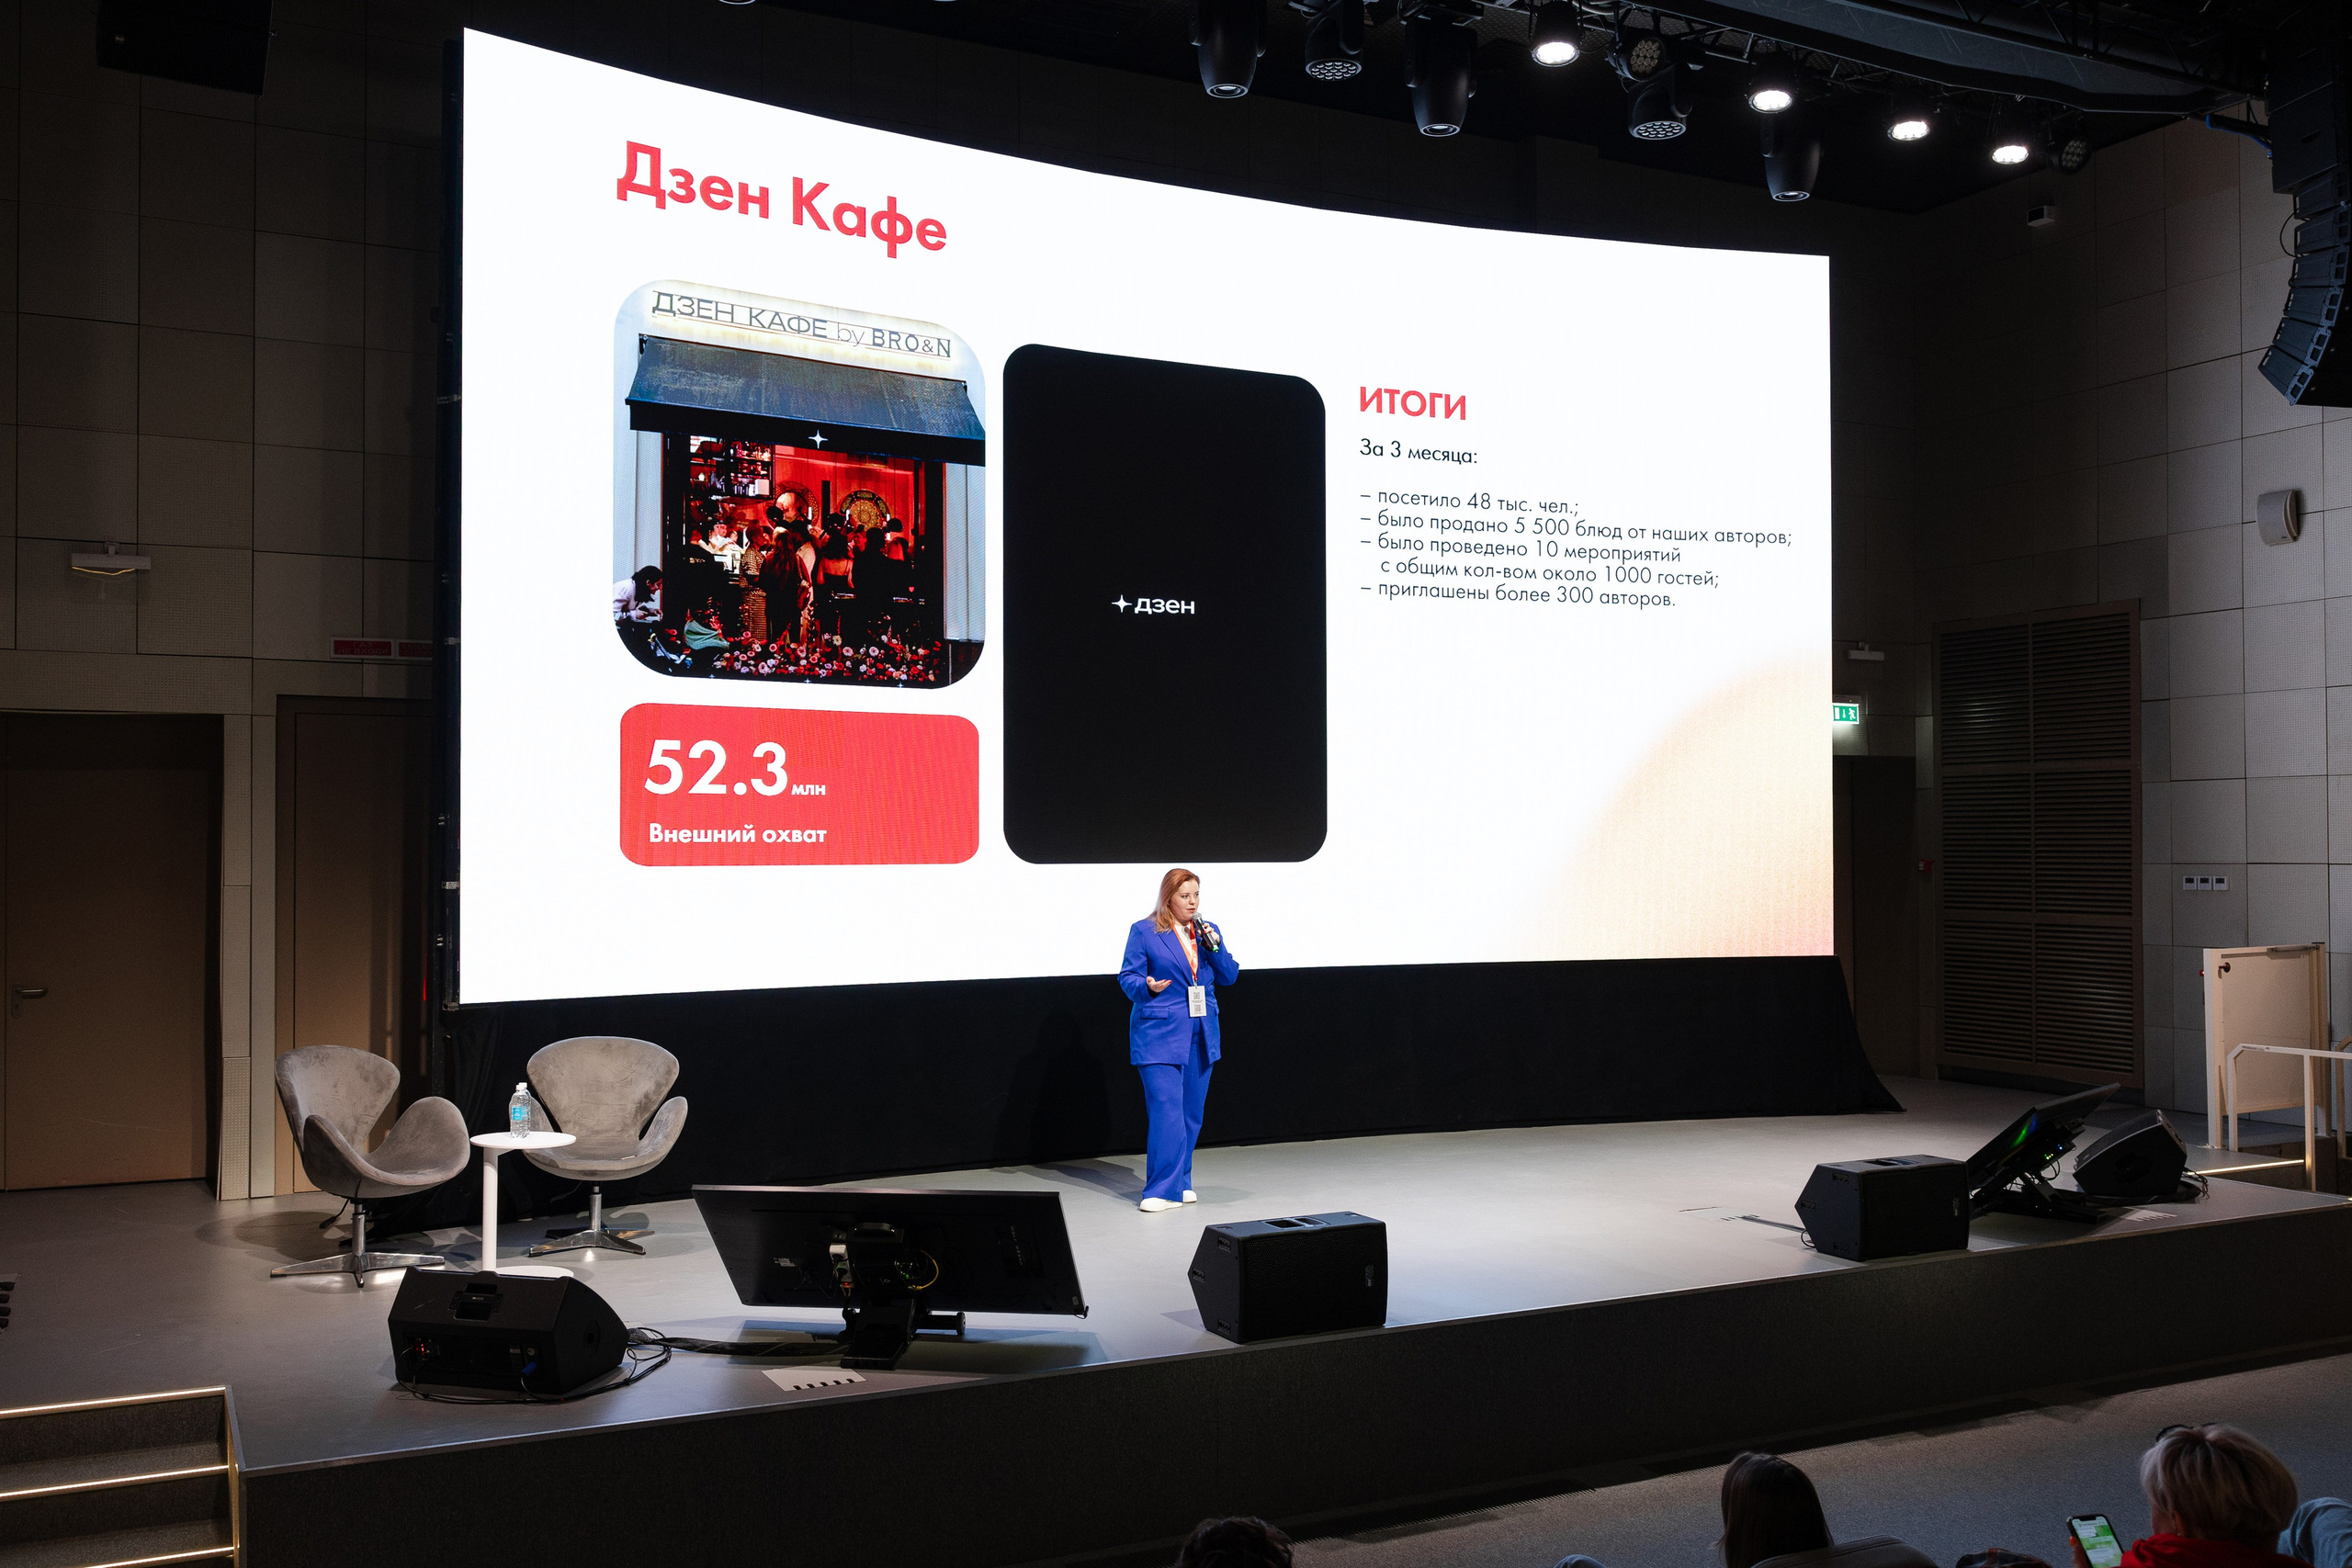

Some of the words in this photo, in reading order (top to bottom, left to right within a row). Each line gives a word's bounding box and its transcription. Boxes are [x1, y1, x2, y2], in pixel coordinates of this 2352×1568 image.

[617, 141, 769, 219] Дзен
[793, 176, 946, 258] Кафе
[652, 291, 734, 323] ДЗЕН
[749, 307, 827, 339] КАФЕ
[837, 322, 865, 347] by
[873, 328, 951, 357] BRO&N
[1361, 387, 1465, 420] ИТОГИ
[1360, 438, 1383, 456] За
[1391, 441, 1401, 457] 3
[1408, 448, 1476, 465] месяца:
[1379, 492, 1460, 507] посетило
[1467, 492, 1490, 509] 48
[1498, 500, 1532, 512] тыс.
[1540, 502, 1577, 516] чел.;
[1378, 509, 1423, 528] было
[1430, 518, 1508, 535] продано
[1514, 517, 1524, 533] 5
[1532, 518, 1569, 536] 500
[1576, 519, 1622, 540] блюд
[1628, 528, 1646, 538] от
[1653, 529, 1708, 541] наших
[1715, 532, 1791, 547] авторов;
[1379, 531, 1423, 550] было
[1430, 541, 1527, 557] проведено
[1537, 540, 1557, 557] 10
[1565, 547, 1679, 565] мероприятий
[1381, 561, 1389, 572] с
[1396, 557, 1457, 577] общим
[1464, 566, 1536, 579] кол-вом
[1544, 570, 1596, 581] около
[1606, 566, 1651, 583] 1000
[1658, 574, 1718, 588] гостей;
[1135, 598, 1194, 615] дзен
[1379, 584, 1488, 600] приглашены
[1496, 583, 1550, 602] более
[1557, 586, 1593, 603] 300
[1600, 593, 1675, 610] авторов.
[645, 740, 787, 795] 52.3
[792, 784, 825, 795] млн
[650, 823, 755, 843] Внешний
[763, 829, 827, 843] охват
